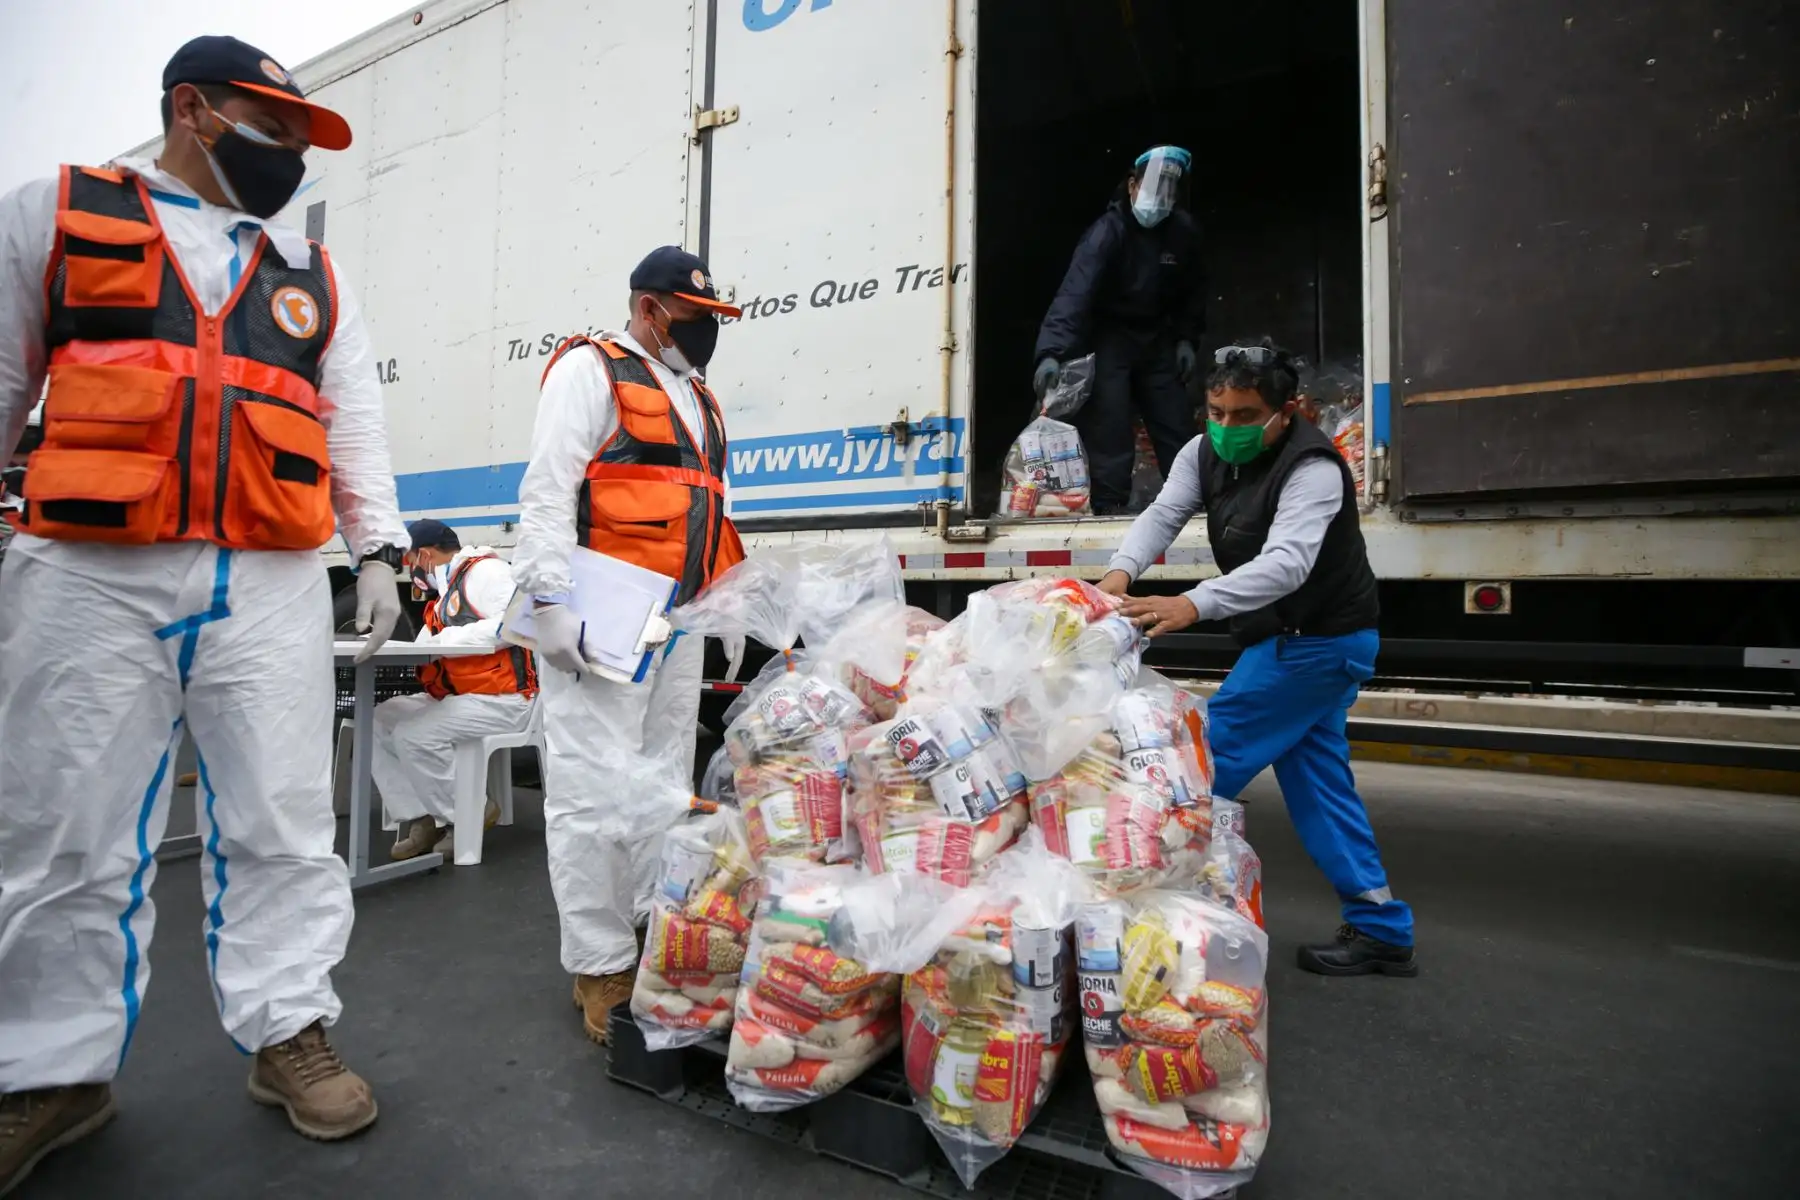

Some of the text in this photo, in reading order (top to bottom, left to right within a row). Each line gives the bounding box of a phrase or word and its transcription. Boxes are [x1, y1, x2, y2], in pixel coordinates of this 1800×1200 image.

[507, 338, 532, 361] Tu
[809, 278, 878, 308] Que
[731, 430, 966, 474] www.jyjtra
[765, 1071, 807, 1084] PAISANA
[1163, 1156, 1220, 1169] PAISANA
